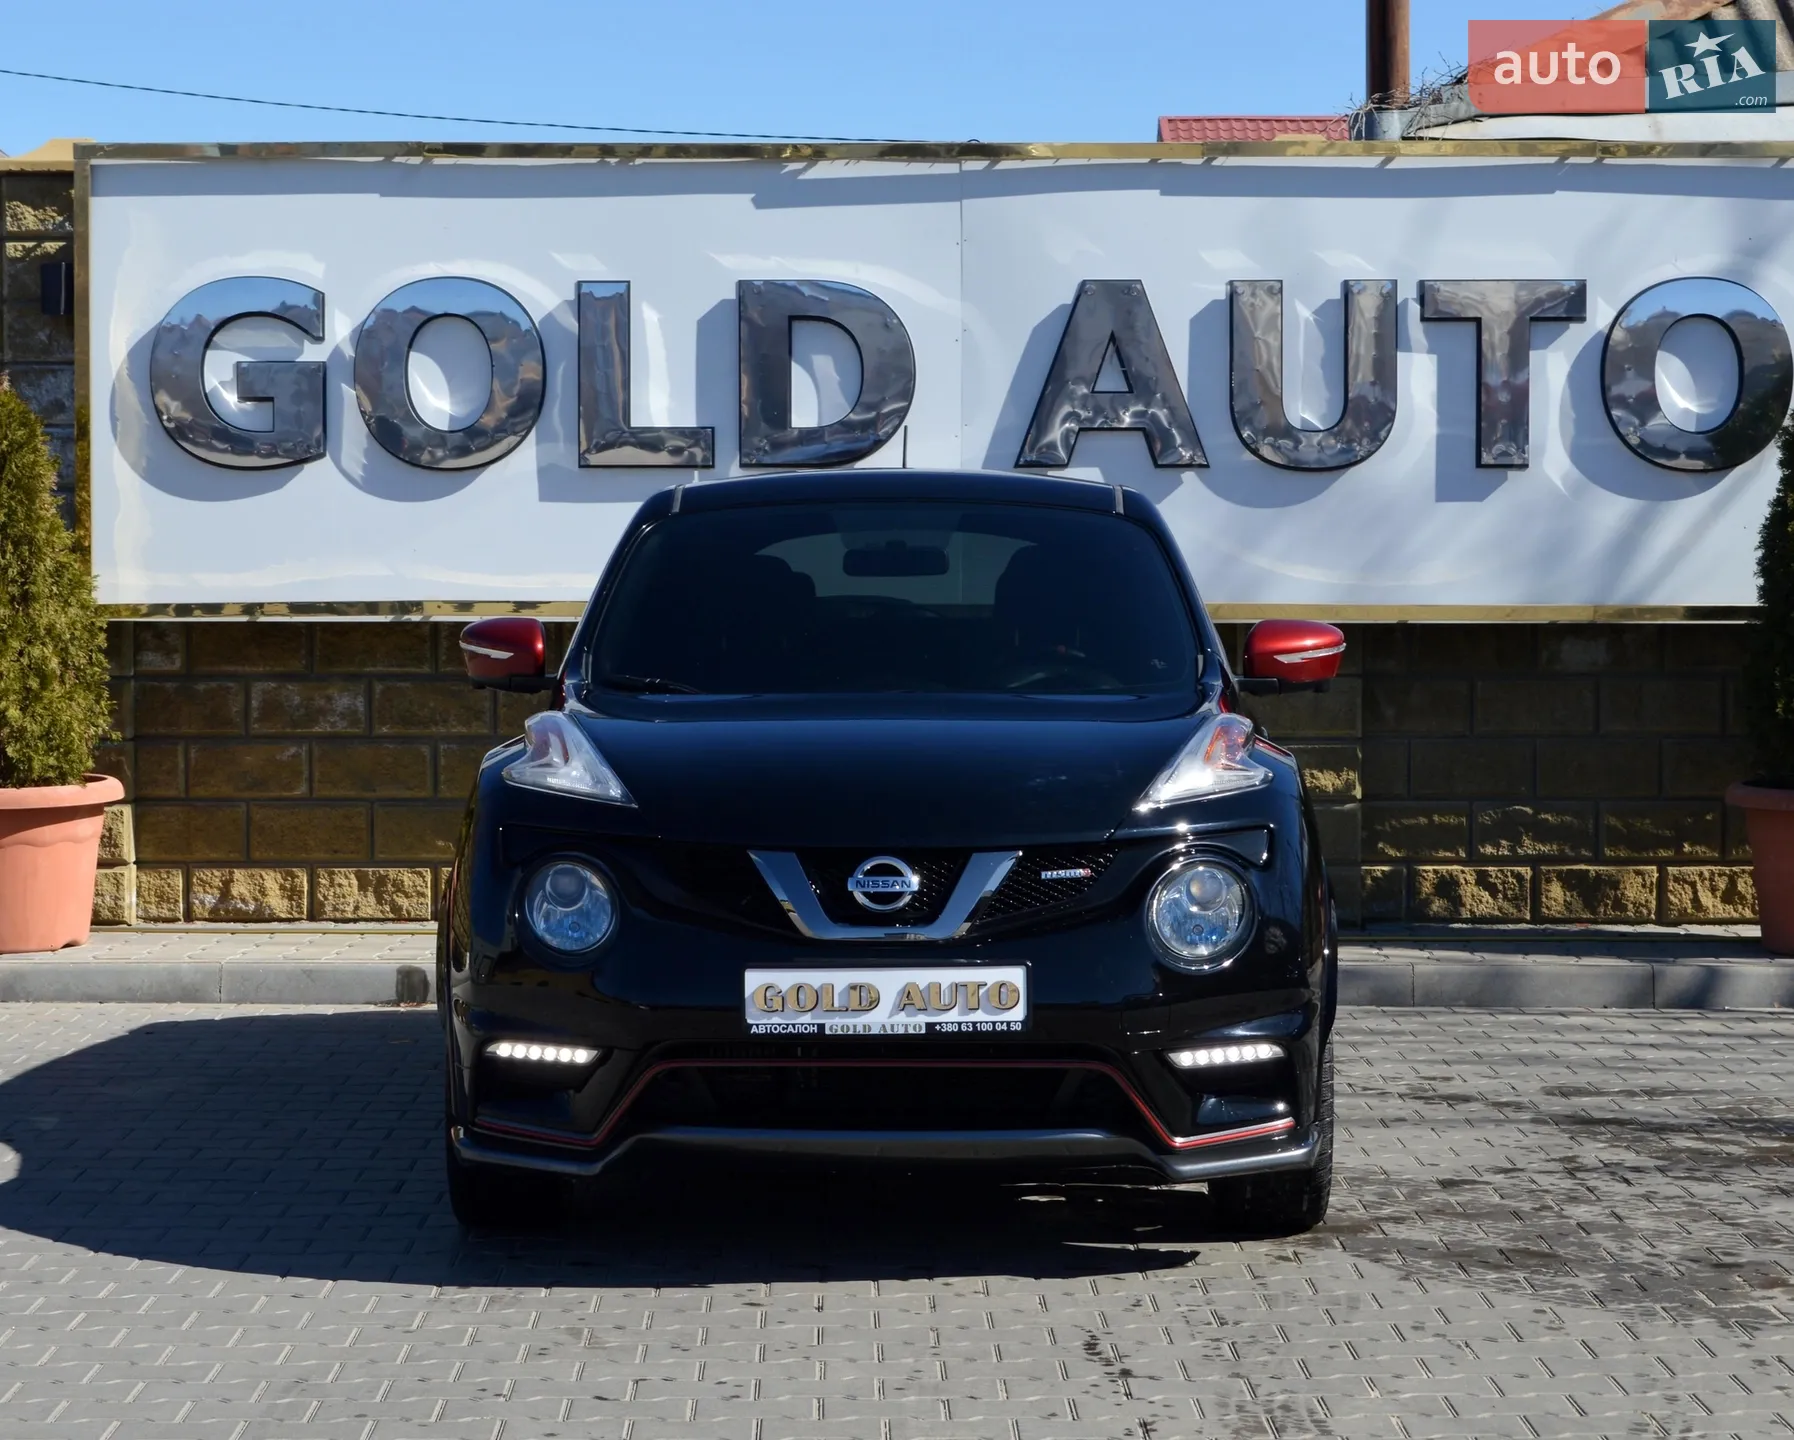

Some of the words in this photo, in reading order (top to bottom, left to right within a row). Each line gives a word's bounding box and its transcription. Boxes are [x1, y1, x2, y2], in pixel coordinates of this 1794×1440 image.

[149, 276, 917, 471] GOLD
[1014, 276, 1793, 473] AUTO
[855, 880, 911, 889] NISSAN
[753, 982, 881, 1013] GOLD
[899, 980, 1021, 1012] AUTO
[750, 1024, 818, 1034] АВТОСАЛОН
[828, 1023, 873, 1034] GOLD
[878, 1023, 923, 1034] AUTO
[934, 1022, 959, 1032] +380
[961, 1022, 973, 1032] 63
[976, 1022, 993, 1031] 100
[995, 1022, 1007, 1031] 04
[1010, 1021, 1022, 1031] 50
